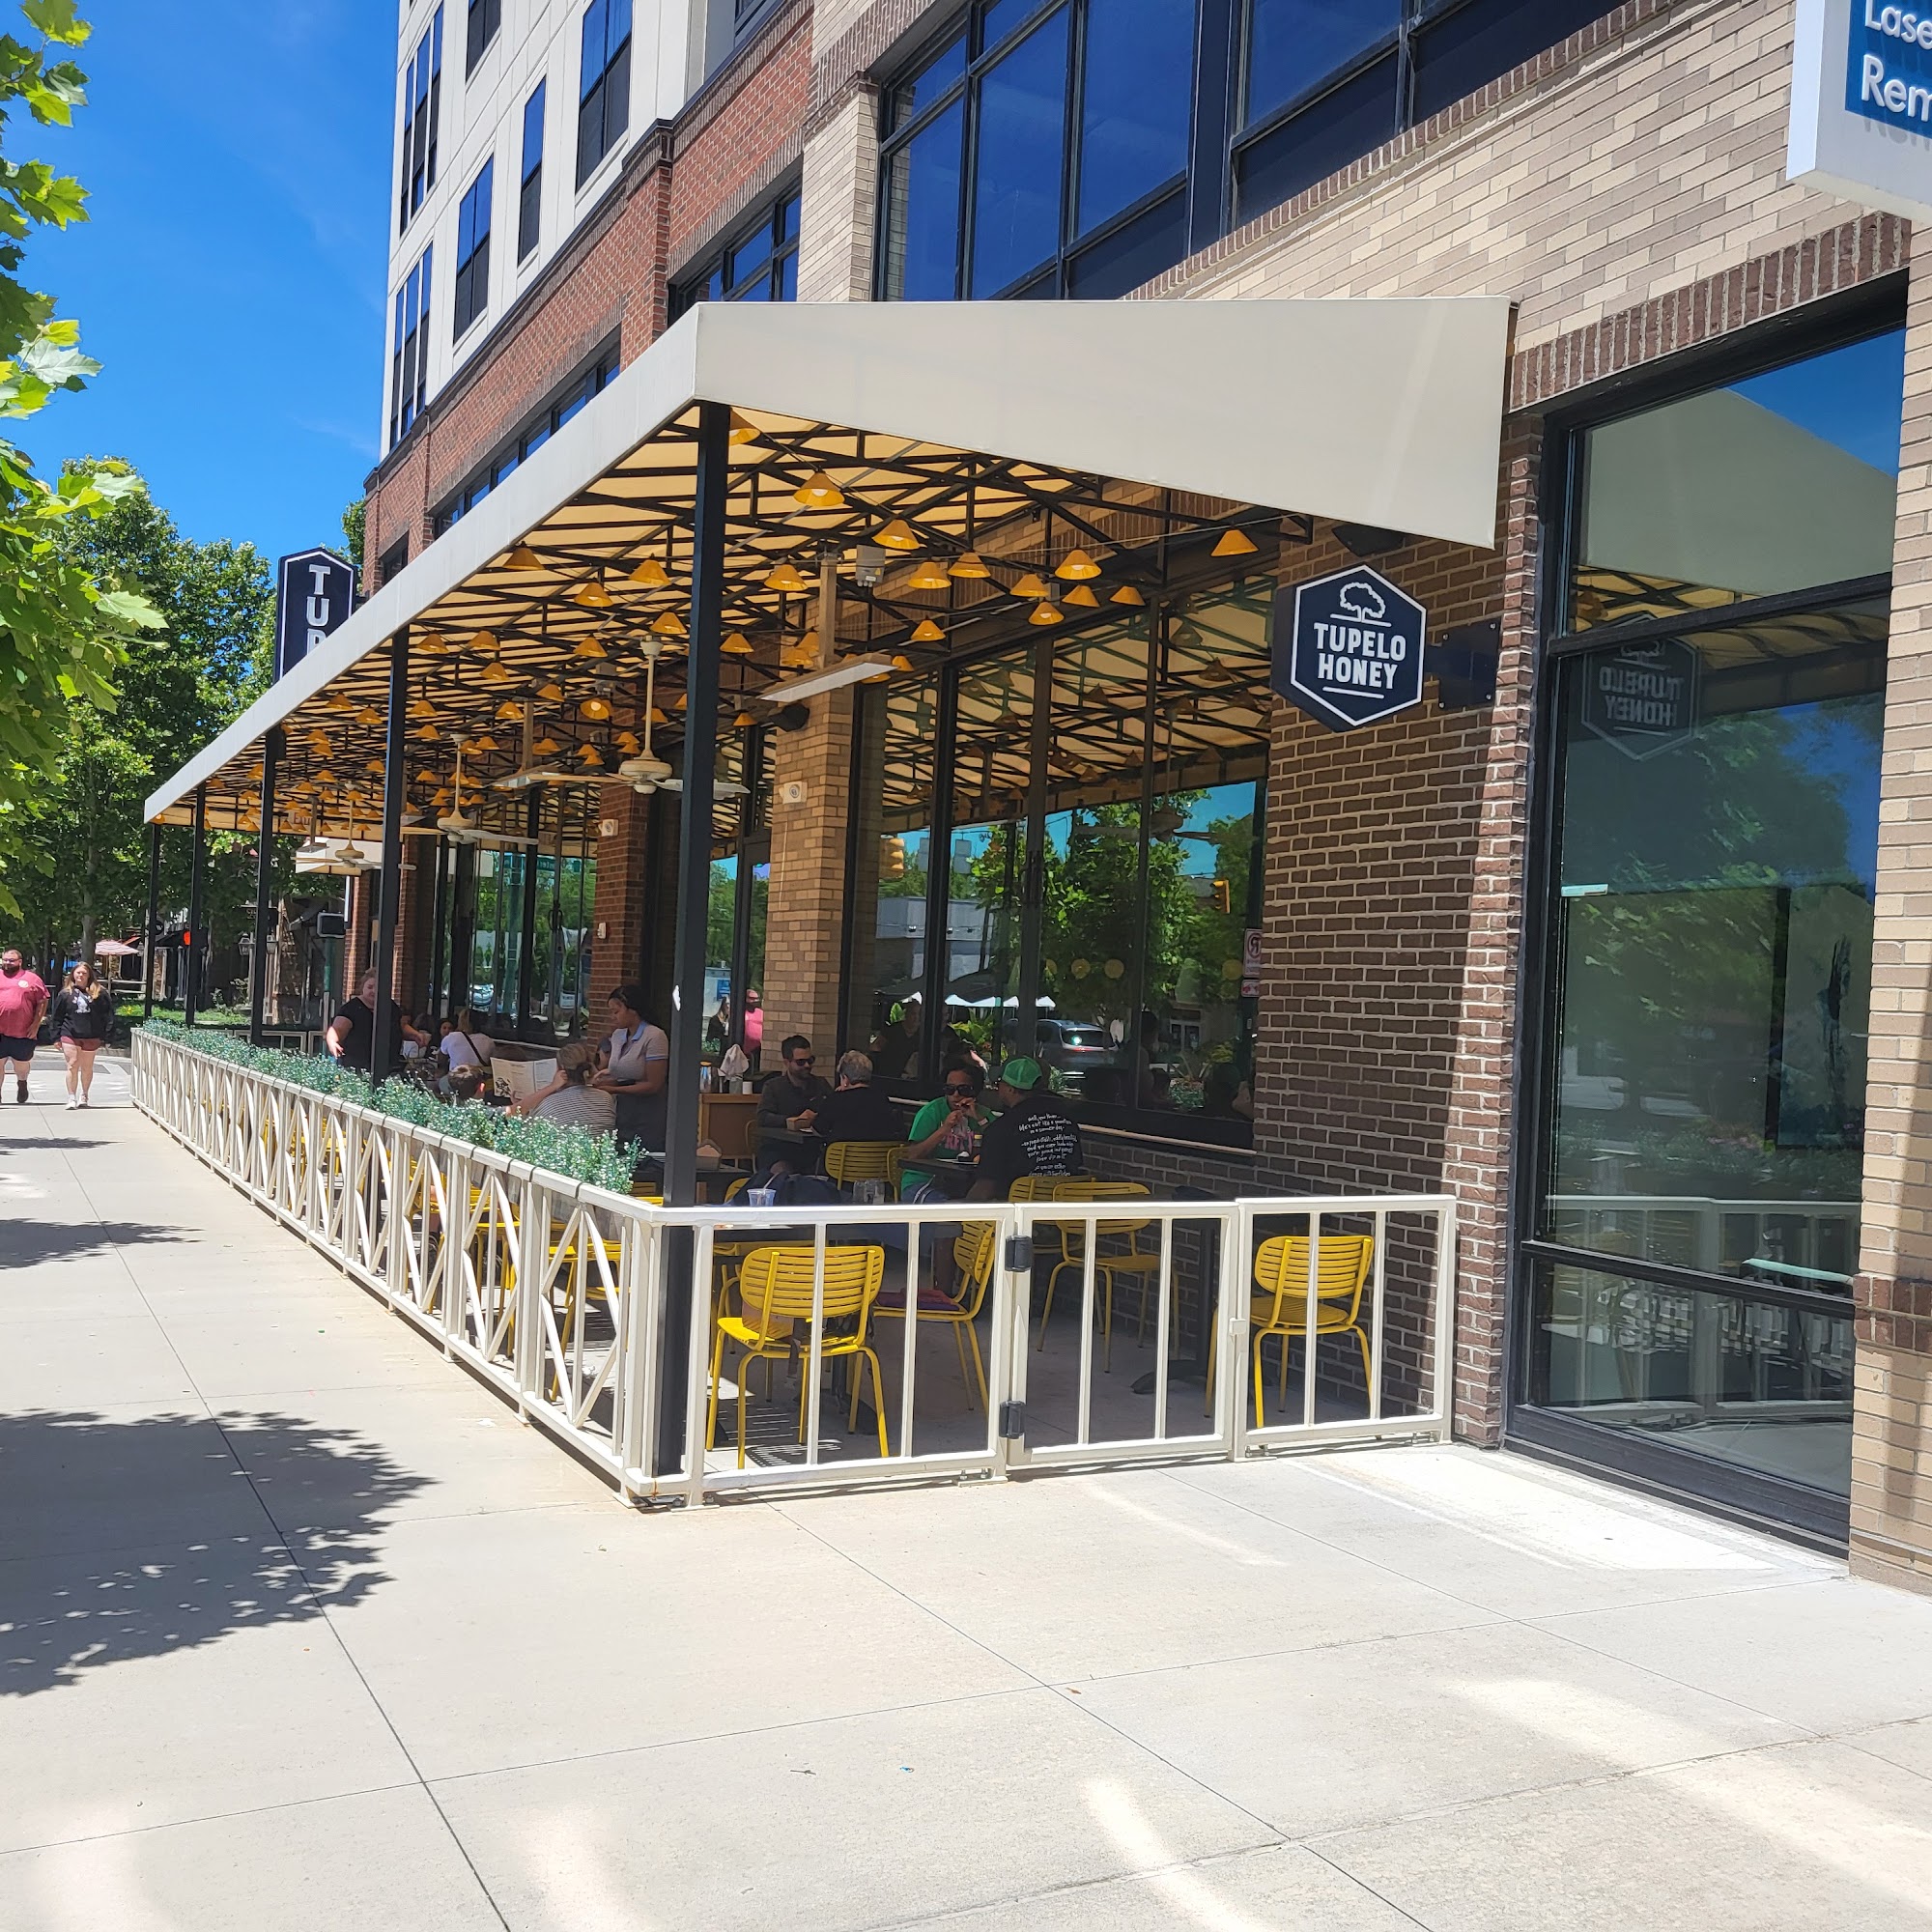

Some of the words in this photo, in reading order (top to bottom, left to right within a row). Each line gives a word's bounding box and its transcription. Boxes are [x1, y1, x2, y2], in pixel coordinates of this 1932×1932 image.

[1865, 0, 1932, 49] Lase
[1314, 622, 1406, 662] TUPELO
[1318, 653, 1398, 689] HONEY
